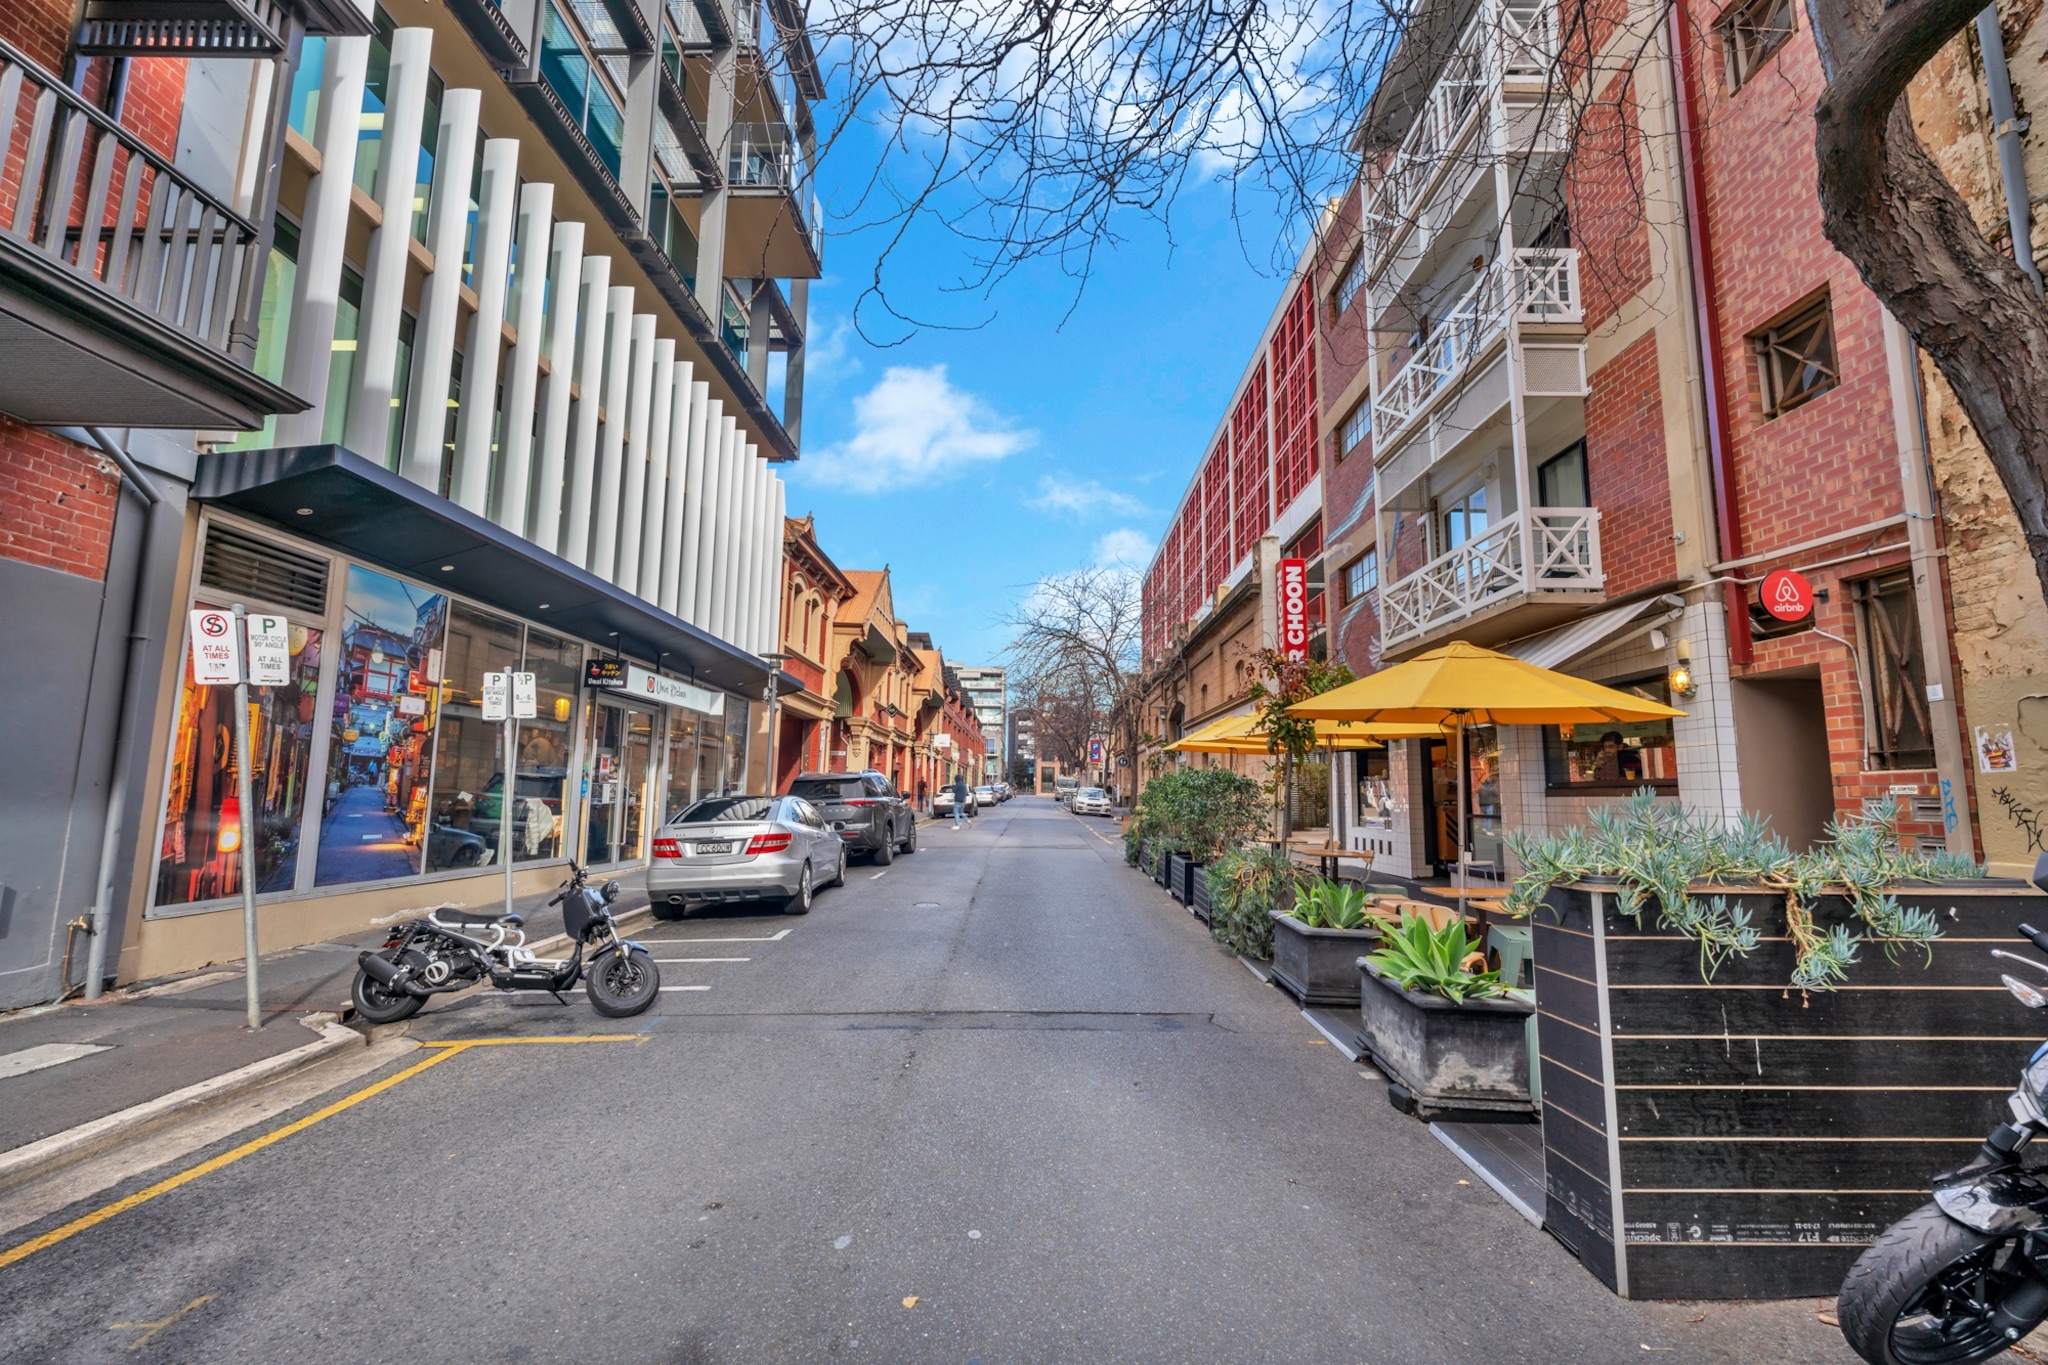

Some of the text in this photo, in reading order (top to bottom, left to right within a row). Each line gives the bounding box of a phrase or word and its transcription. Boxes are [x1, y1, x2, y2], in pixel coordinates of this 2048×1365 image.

[1286, 566, 1304, 645] CHOON
[1774, 602, 1804, 613] airbnb
[262, 618, 276, 633] P
[251, 634, 269, 642] MOTOR
[204, 652, 230, 660] TIMES
[492, 675, 501, 686] P
[602, 677, 624, 686] Kitchen
[1798, 1232, 1820, 1242] F17
